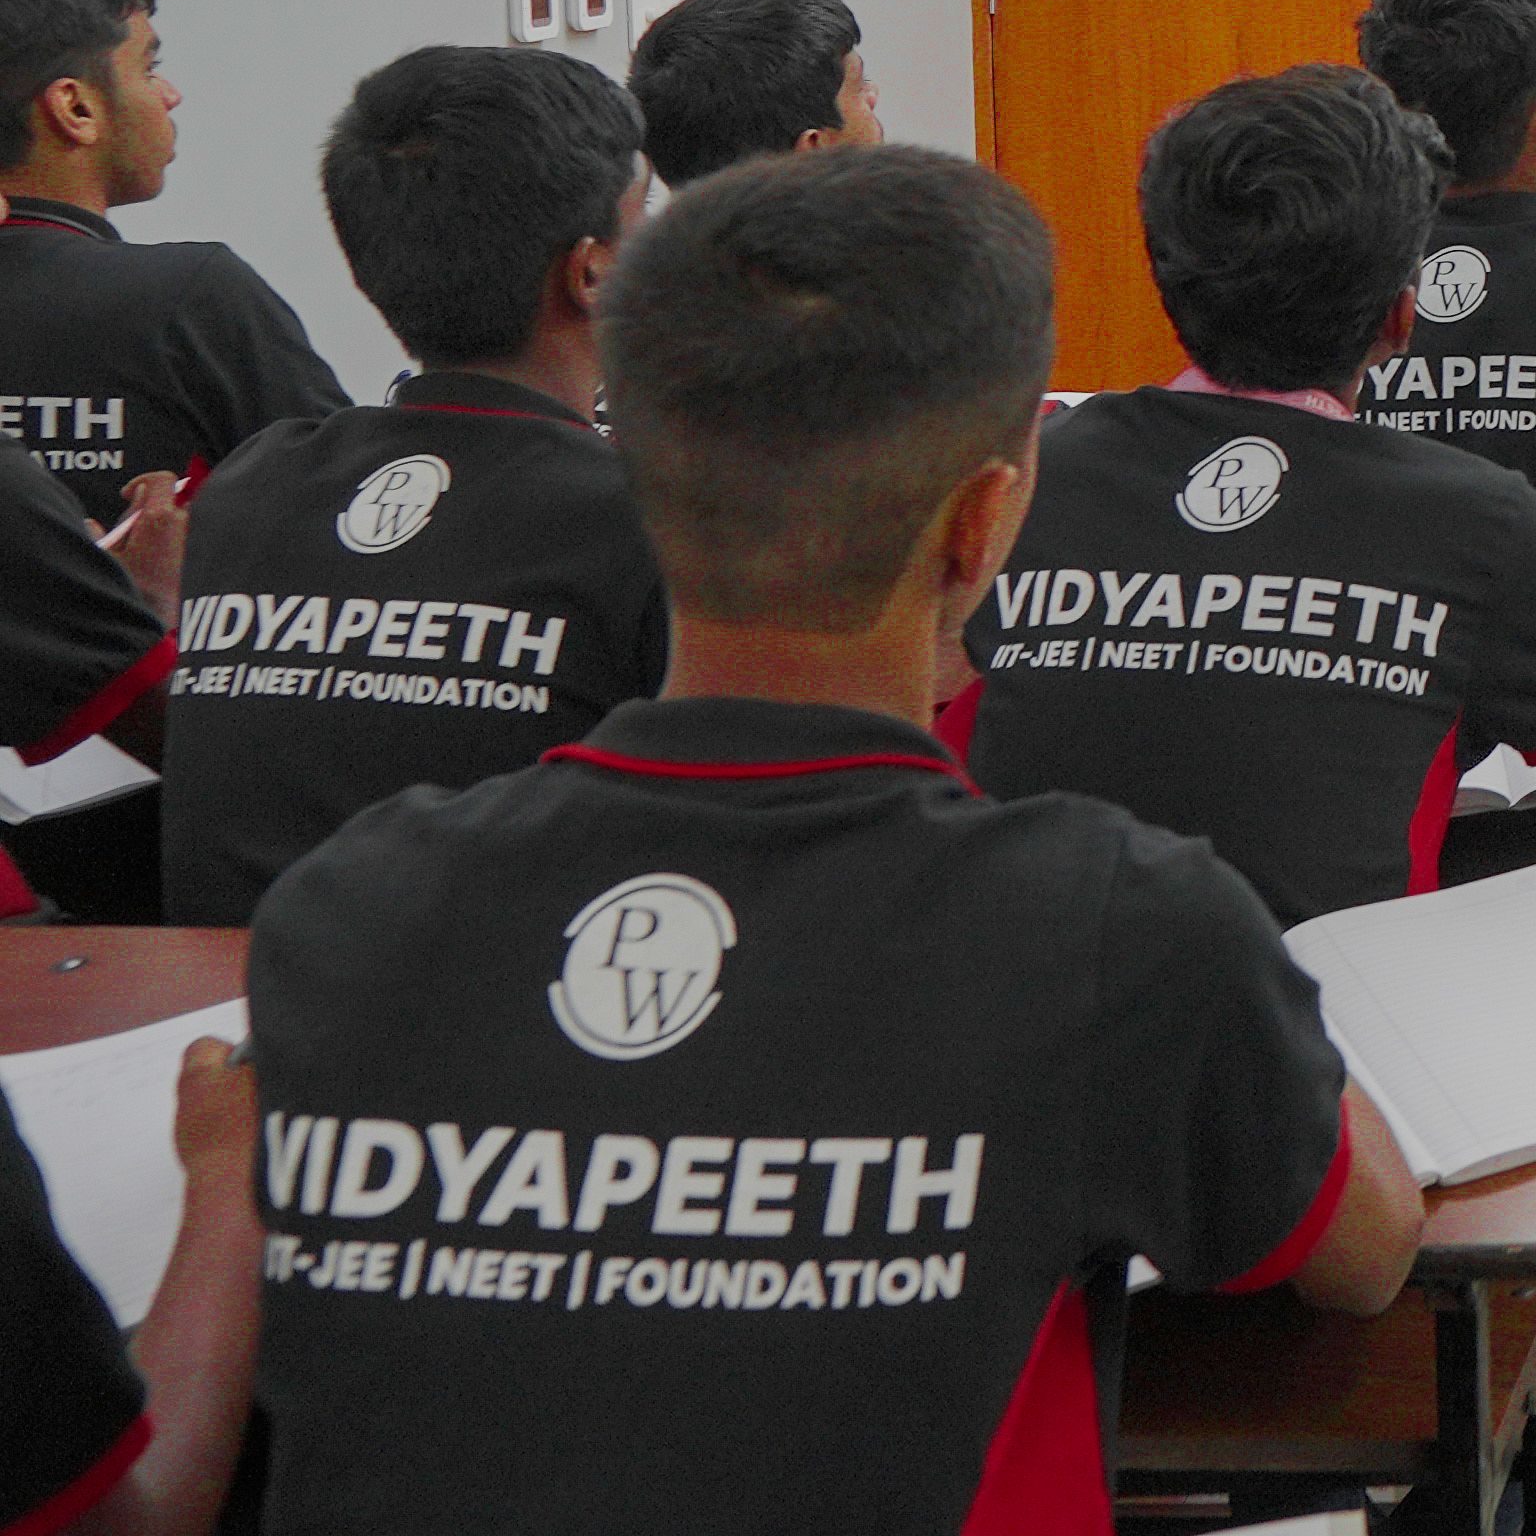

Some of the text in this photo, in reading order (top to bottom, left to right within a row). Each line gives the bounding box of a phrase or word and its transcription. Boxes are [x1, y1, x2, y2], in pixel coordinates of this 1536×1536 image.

[178, 593, 567, 675] VIDYAPEETH
[996, 569, 1449, 658] VIDYAPEETH
[243, 666, 321, 696] NEET
[332, 669, 551, 714] FOUNDATION
[990, 639, 1429, 697] IIT-JEE NEET FOUNDATION
[263, 1110, 985, 1237] VIDYAPEETH
[426, 1245, 568, 1303] NEET
[592, 1251, 966, 1312] FOUNDATION
